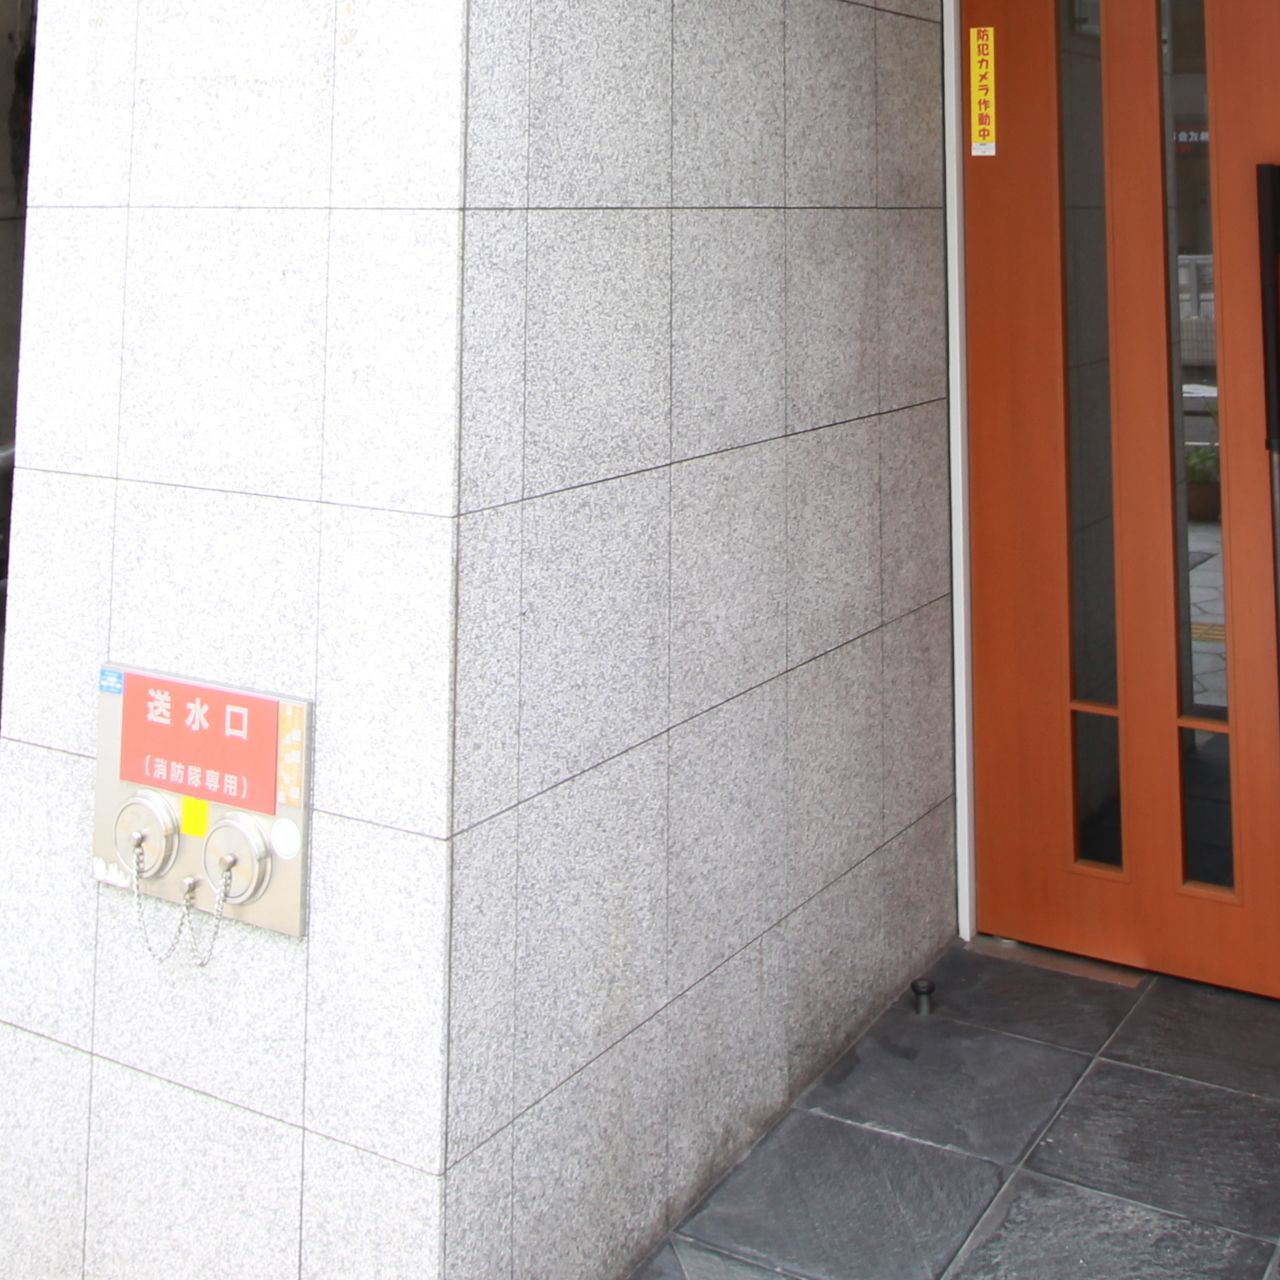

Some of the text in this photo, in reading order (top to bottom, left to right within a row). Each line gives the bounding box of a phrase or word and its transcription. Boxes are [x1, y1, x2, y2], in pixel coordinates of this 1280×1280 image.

[976, 27, 991, 141] 防犯カメラ作動中
[146, 688, 249, 740] 送水口
